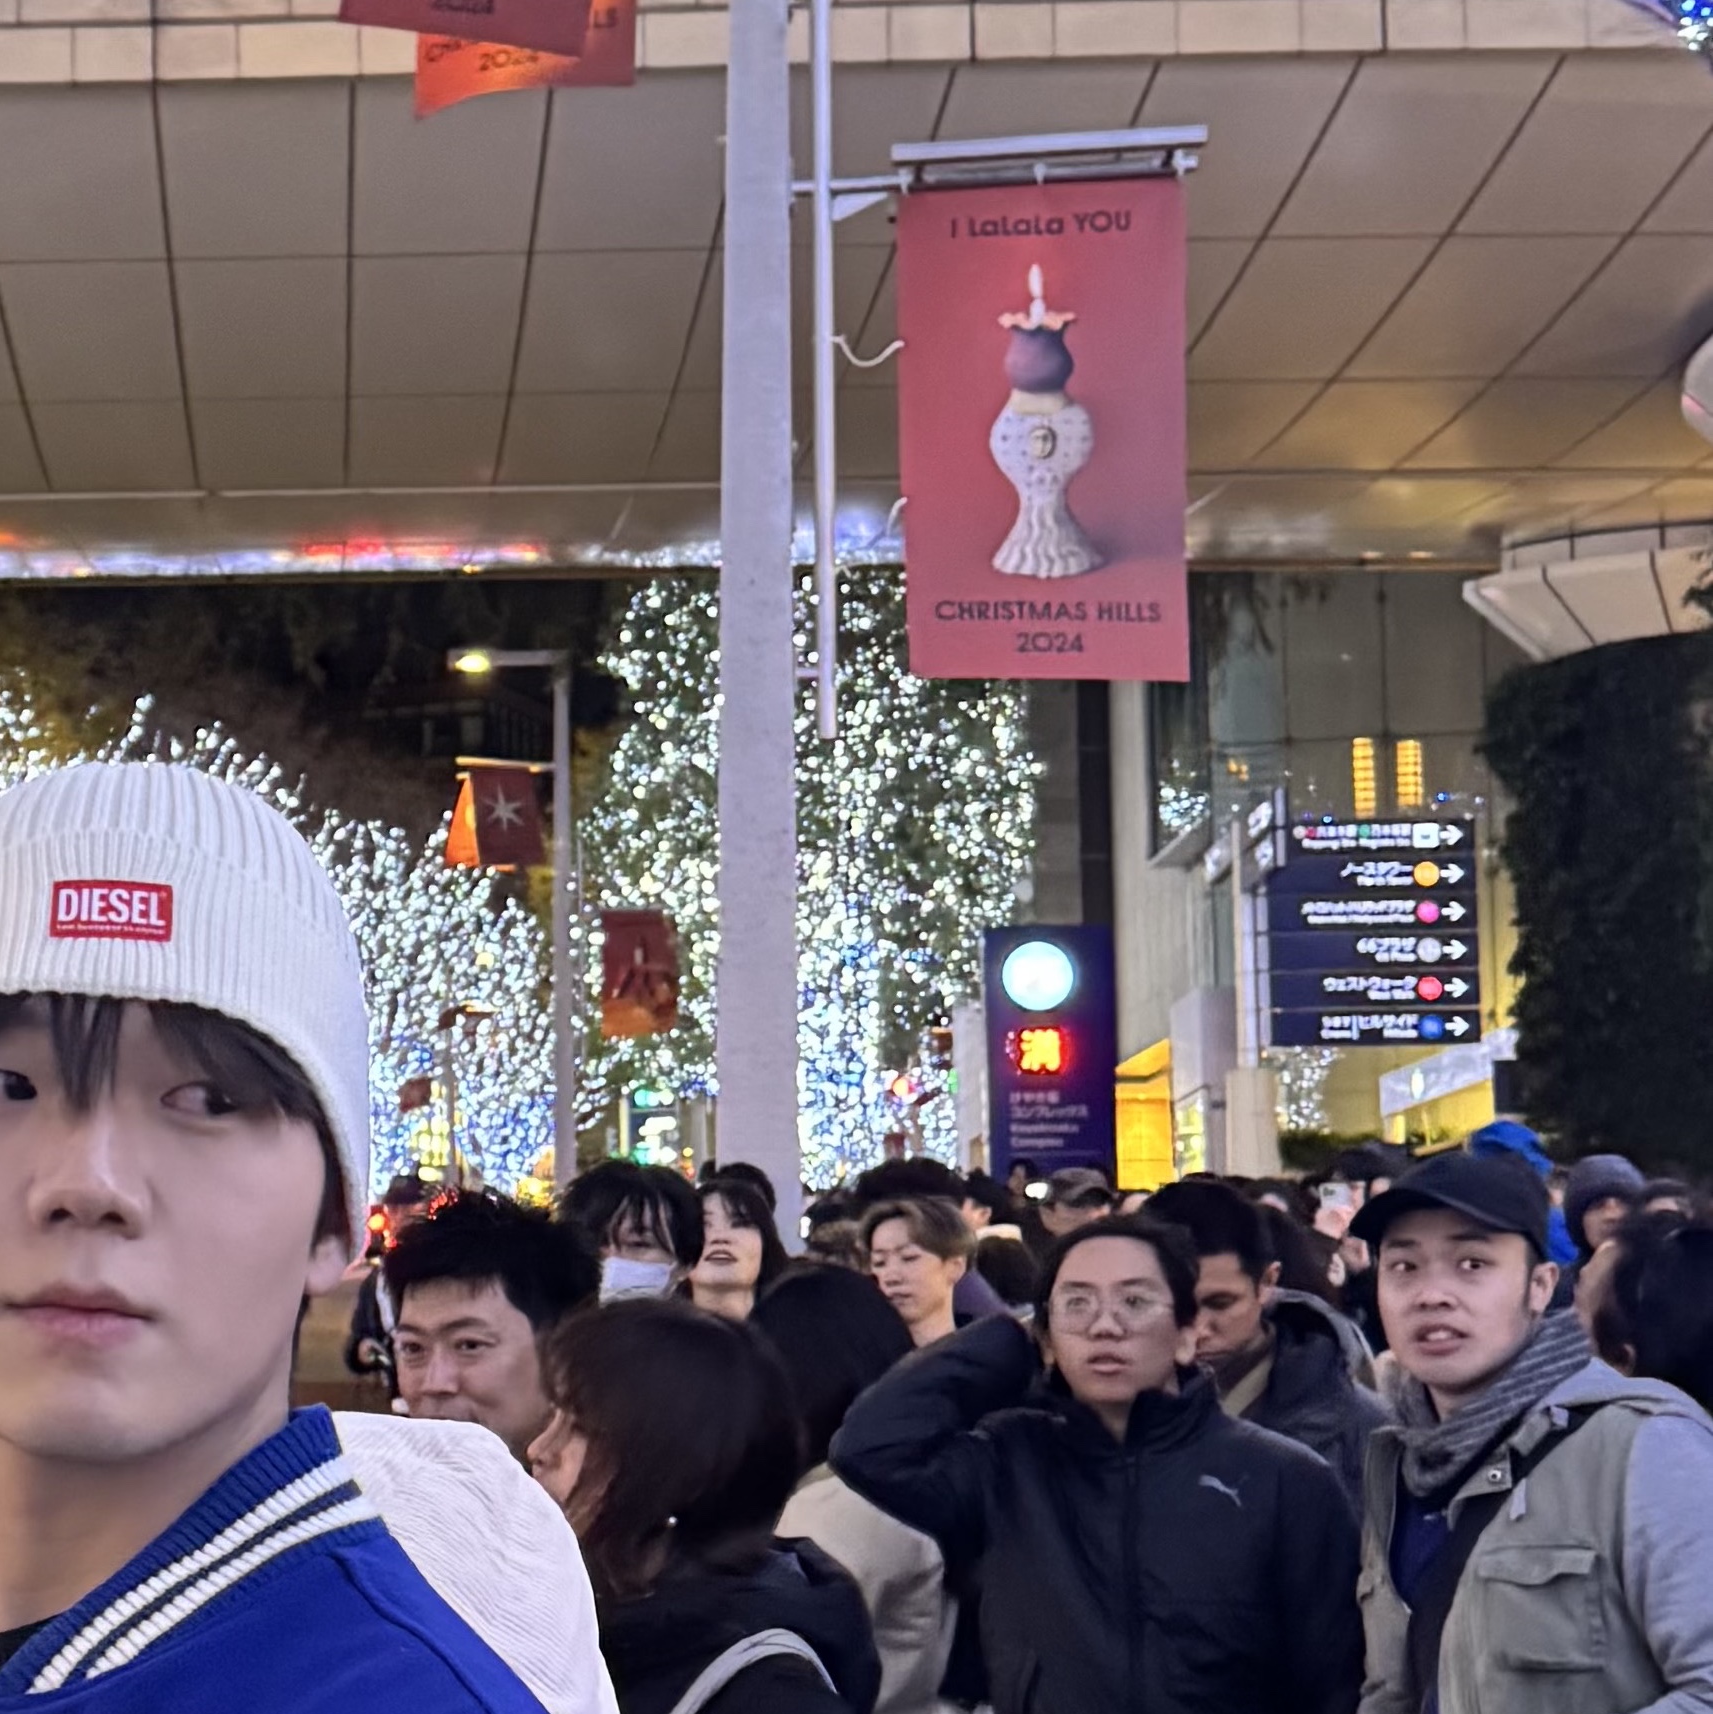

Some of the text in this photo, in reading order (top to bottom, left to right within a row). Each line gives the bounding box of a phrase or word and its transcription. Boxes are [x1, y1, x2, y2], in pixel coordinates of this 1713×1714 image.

[950, 218, 957, 239] I
[1074, 210, 1131, 233] YOU
[935, 600, 1161, 623] CHRISTMAS HILLS
[1016, 631, 1084, 653] 2024
[57, 888, 166, 926] DIESEL
